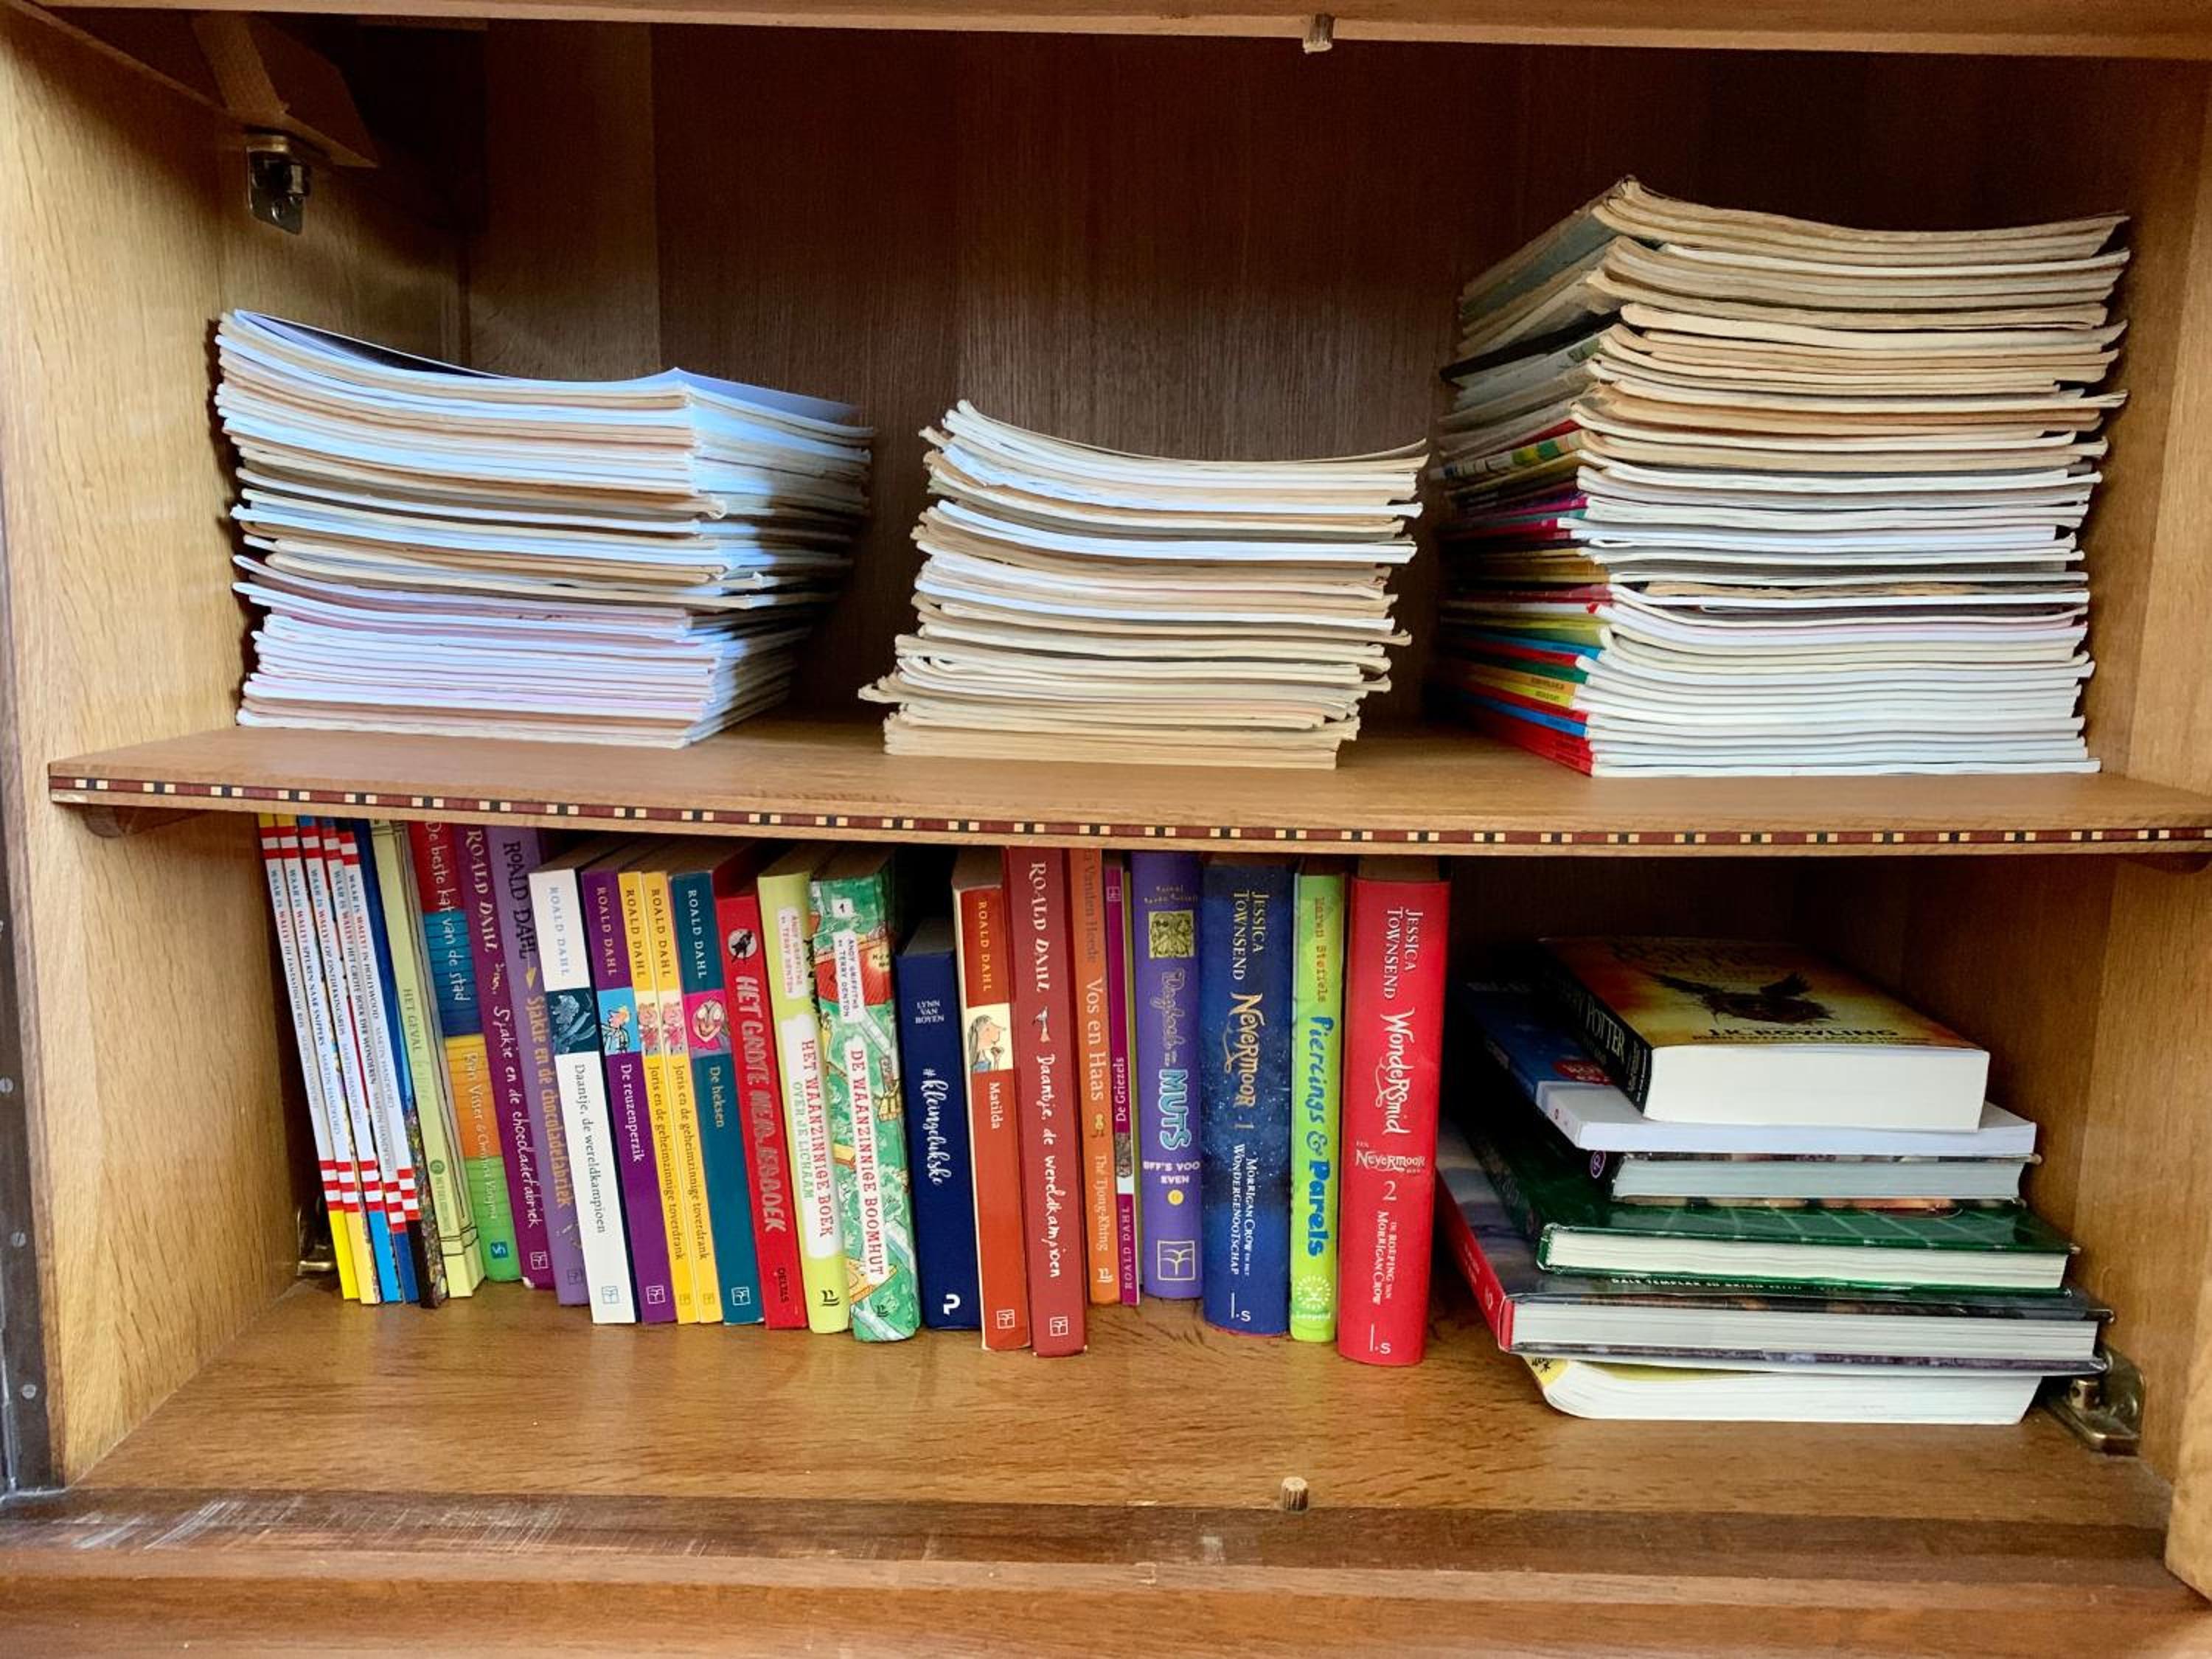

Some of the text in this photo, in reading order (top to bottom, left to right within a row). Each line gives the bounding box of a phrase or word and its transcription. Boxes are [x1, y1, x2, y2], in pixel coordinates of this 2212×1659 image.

[425, 819, 470, 1002] De beste kat van de stad
[464, 830, 499, 953] ROALD DAHL
[503, 841, 538, 959] ROALD DAHL
[549, 886, 570, 976] ROALD DAHL
[597, 886, 616, 976] ROALD DAHL
[625, 888, 646, 978] ROALD DAHL
[651, 888, 671, 978] ROALD DAHL
[687, 888, 707, 978] ROALD DAHL
[1028, 861, 1051, 992] ROALD DAHL
[1084, 866, 1097, 914] Vanden
[1231, 890, 1249, 980] TOWNSEND
[1248, 891, 1270, 953] JESSICA
[977, 901, 992, 991] ROALD DAHL
[1085, 920, 1099, 963] Heede
[1316, 945, 1327, 1002] Stoffels
[1382, 906, 1403, 1000] TOWNSEND
[1400, 908, 1423, 971] JESSICA
[403, 988, 415, 1011] HET
[408, 1014, 422, 1052] GEVAL
[731, 975, 758, 1019] HET
[841, 981, 849, 1016] DENTON
[1085, 977, 1107, 1100] Vos en Haas
[1585, 995, 1625, 1063] POTTER
[709, 1065, 728, 1127] De heksen
[737, 1020, 766, 1087] GROTE
[1113, 1057, 1126, 1121] De Griezels
[468, 1084, 486, 1120] Visser
[490, 1004, 544, 1228] Sjakie en de chocoladefabriek
[524, 995, 574, 1208] Sjakie en de chocoladefabriek
[619, 1063, 644, 1163] De reuzenperzik
[792, 1081, 814, 1199] OVER JE LICHAAM
[801, 1039, 835, 1237] HET WAANZINNIGE BOEK
[919, 1067, 955, 1186] #kleingelukske
[989, 1082, 1002, 1130] Matilda
[1158, 1068, 1192, 1150] MUTS
[1304, 1015, 1334, 1257] Piercings & Parels
[572, 1063, 608, 1234] Daantje, de wereldkampioen
[647, 1065, 685, 1260] Joris en de geheimzinnige toverdrank
[672, 1065, 709, 1260] Joris en de geheimzinnige toverdrank
[849, 1048, 884, 1276] DE WAANZINNIGE BOOMHUT
[1034, 1053, 1068, 1278] Daantje, de wereldkampioen
[1161, 1175, 1189, 1184] EVEN
[1177, 1161, 1200, 1171] VOO
[1244, 1158, 1258, 1217] MORRIGAN
[1382, 1180, 1397, 1201] 2
[1093, 1180, 1109, 1251] Tjong-Khing
[1121, 1206, 1133, 1289] ROALD DAHL
[1228, 1144, 1245, 1274] WONDERGENOOTSCHAP
[1242, 1219, 1255, 1251] CROW
[776, 1267, 789, 1303] DELTAS
[1371, 1210, 1388, 1305] MORRIGAN CROW
[1385, 1234, 1397, 1281] ROEPING
